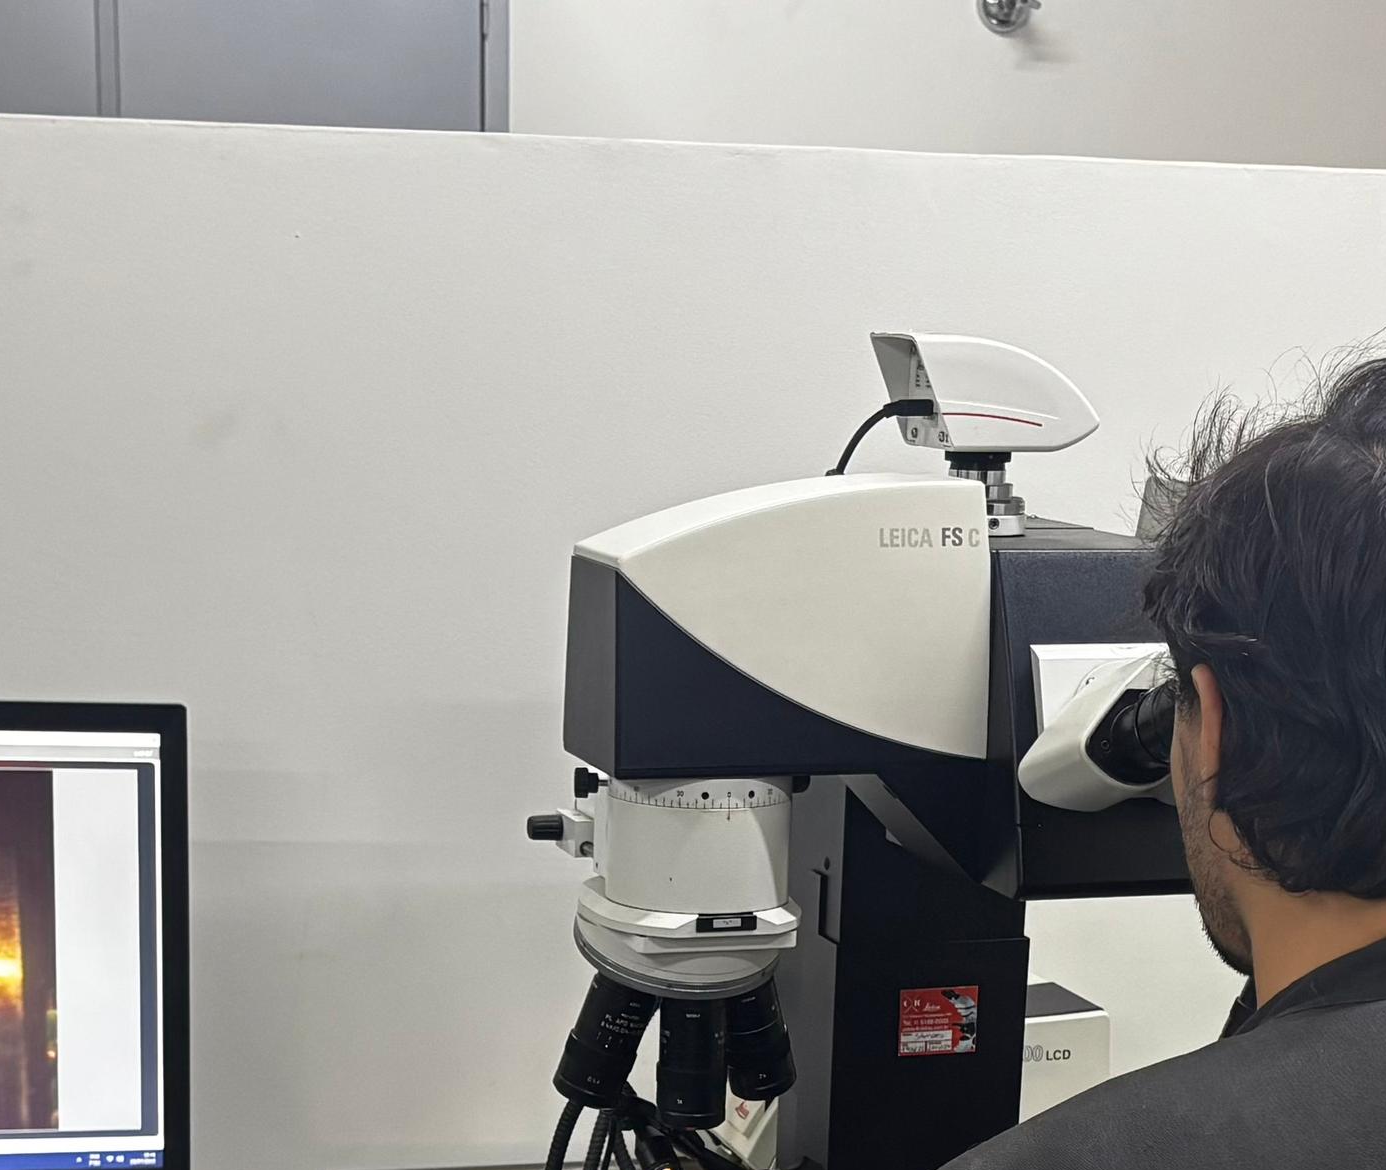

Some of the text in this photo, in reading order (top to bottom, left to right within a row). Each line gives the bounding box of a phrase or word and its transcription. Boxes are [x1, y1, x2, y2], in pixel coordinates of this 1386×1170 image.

[878, 526, 981, 549] LEICA FS C
[1045, 1048, 1071, 1061] LCD
